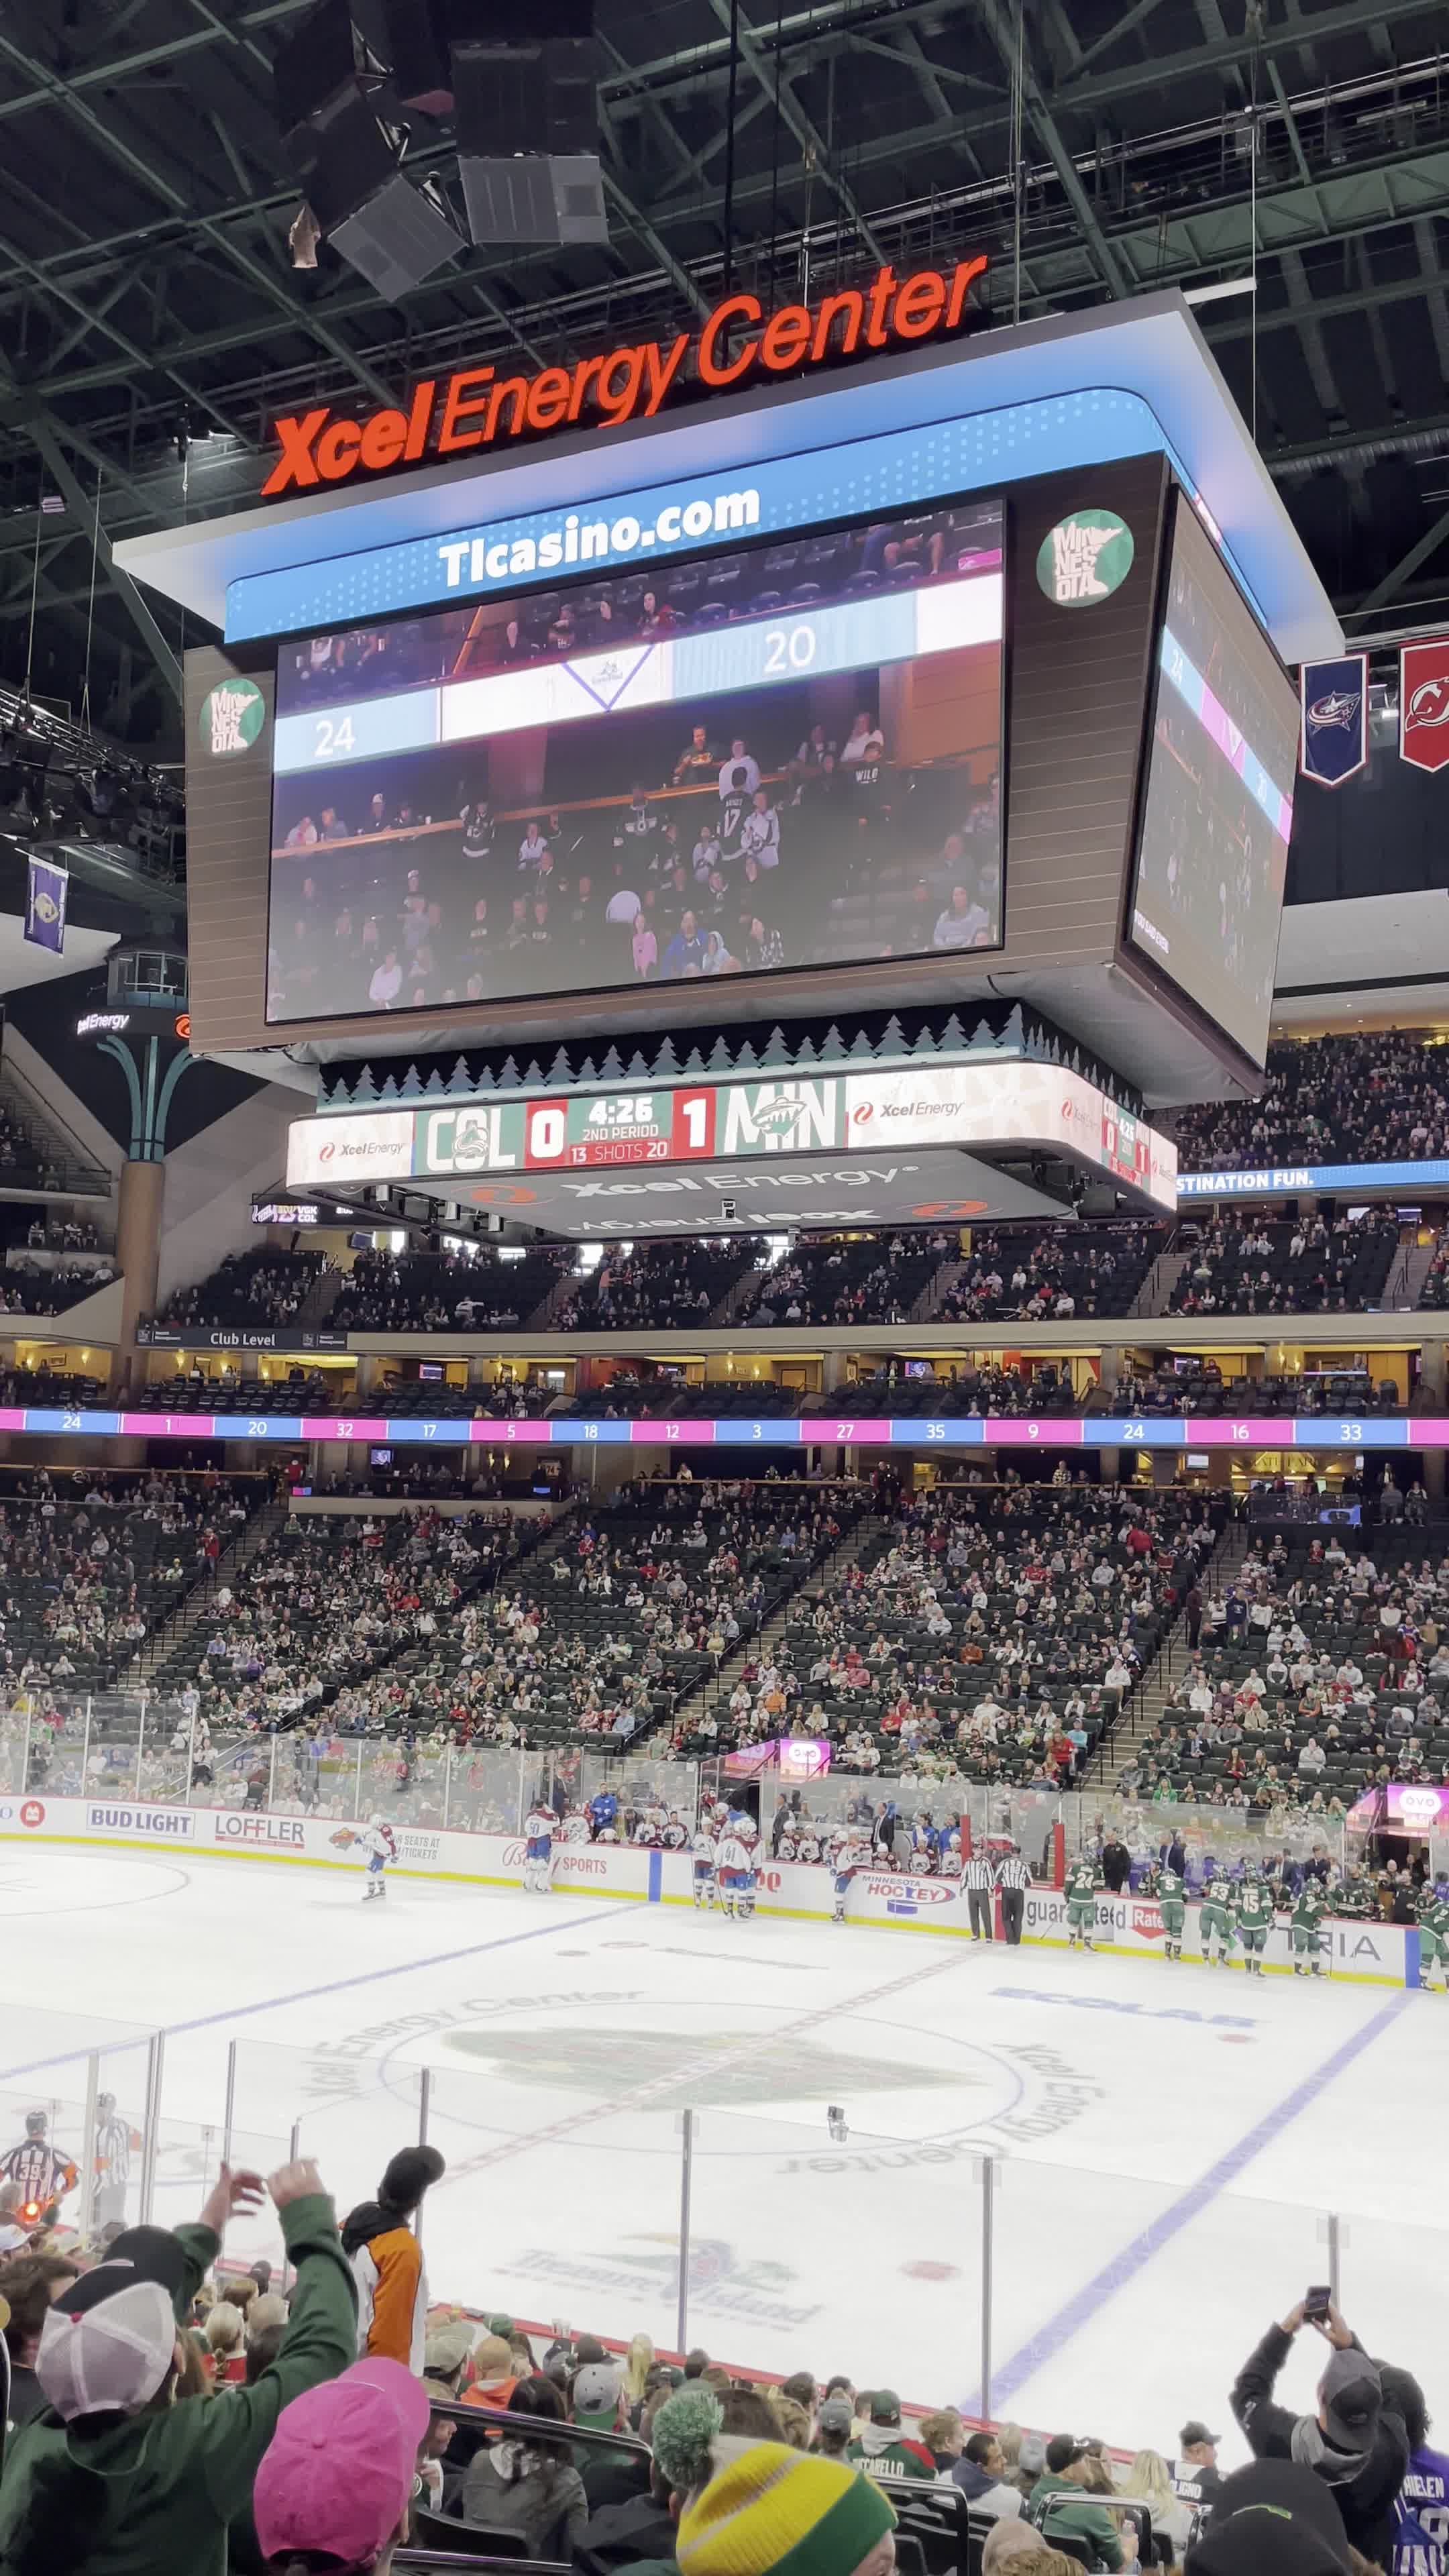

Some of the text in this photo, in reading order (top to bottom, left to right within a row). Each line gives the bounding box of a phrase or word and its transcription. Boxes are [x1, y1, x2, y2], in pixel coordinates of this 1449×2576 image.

[260, 256, 988, 495] Xcel Energy Center
[764, 625, 816, 673] 20
[314, 716, 356, 757] 24
[89, 1014, 130, 1030] Energy
[879, 1100, 963, 1118] Xcel Energy
[427, 1080, 837, 1171] COL 0 4:26 1 MIN
[582, 1124, 659, 1141] 2ND PERIOD
[340, 1142, 402, 1156] Xcel Energy
[572, 1141, 668, 1163] 13 SHOTS 20
[1273, 1171, 1314, 1187] FUN.
[561, 1178, 702, 1197] Xcel
[210, 1332, 276, 1346] Club Level
[62, 1416, 81, 1429] 24
[165, 1419, 172, 1432] 1
[248, 1421, 268, 1435] 20
[335, 1423, 354, 1437] 32
[423, 1425, 437, 1438] 17
[507, 1426, 516, 1438] 5
[584, 1426, 598, 1438] 18
[665, 1426, 680, 1438] 12
[752, 1425, 761, 1438] 3
[837, 1425, 855, 1438] 27
[926, 1425, 945, 1439] 35
[1028, 1424, 1039, 1439] 9
[1124, 1424, 1145, 1440] 24
[1231, 1424, 1250, 1440] 16
[1340, 1424, 1362, 1441] 33
[91, 1809, 191, 1835] BUD LIGHT
[215, 1815, 305, 1842] LOFFLER
[563, 1857, 607, 1875] SPORTS
[862, 1875, 920, 1888] MINNESOTA
